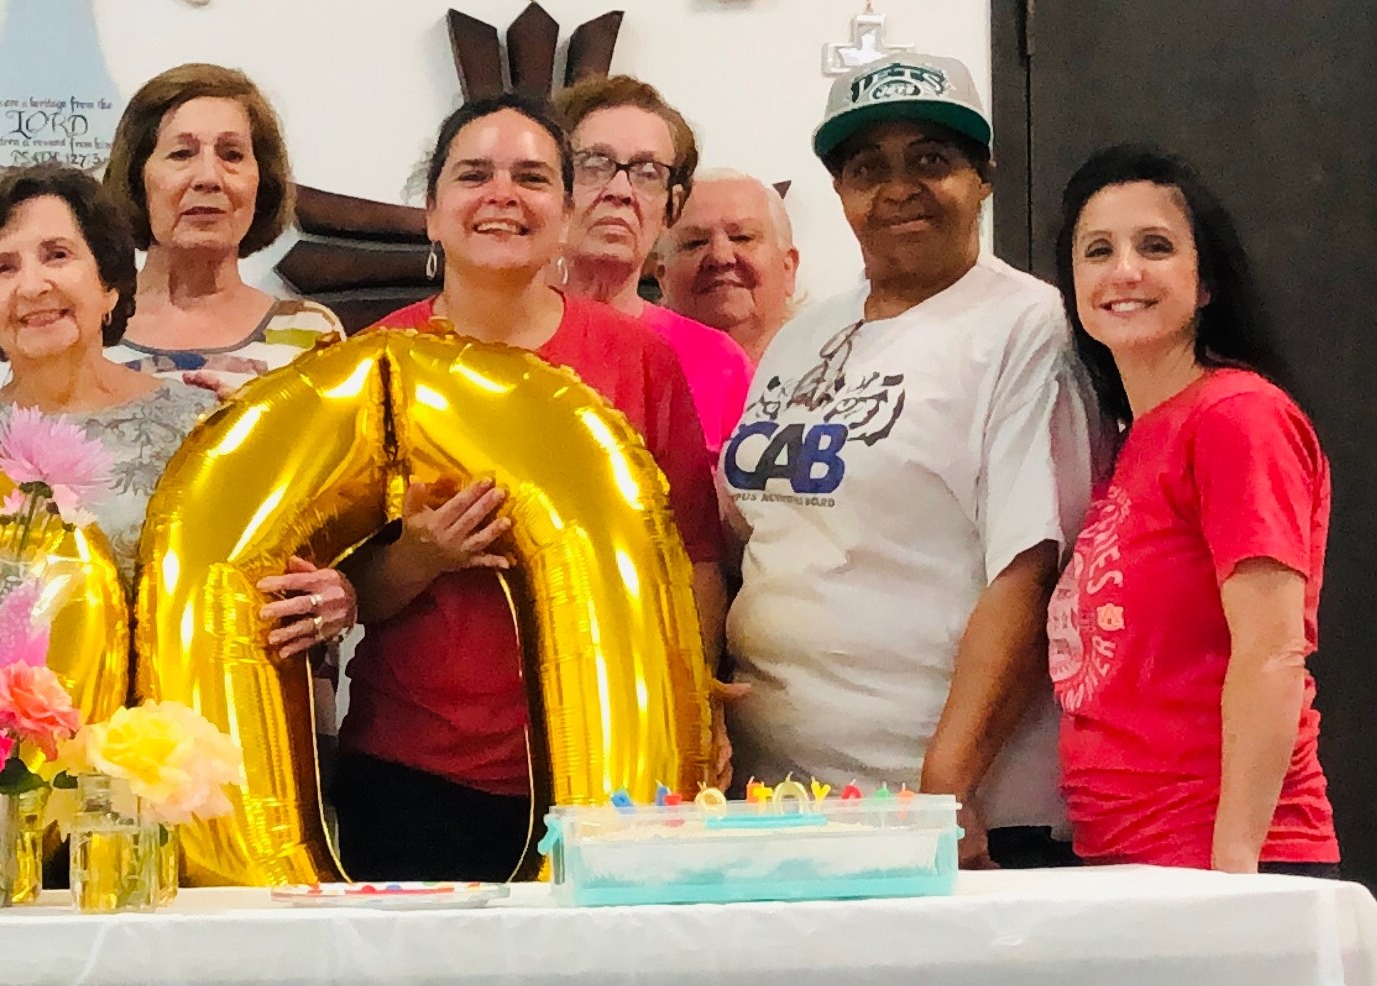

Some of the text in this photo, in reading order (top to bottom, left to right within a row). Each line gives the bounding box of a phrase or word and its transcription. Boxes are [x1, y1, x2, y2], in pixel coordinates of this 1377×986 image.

[851, 64, 944, 101] JETS
[69, 95, 94, 113] from
[5, 110, 88, 139] LORD
[70, 137, 92, 152] from
[724, 421, 849, 494] CAB
